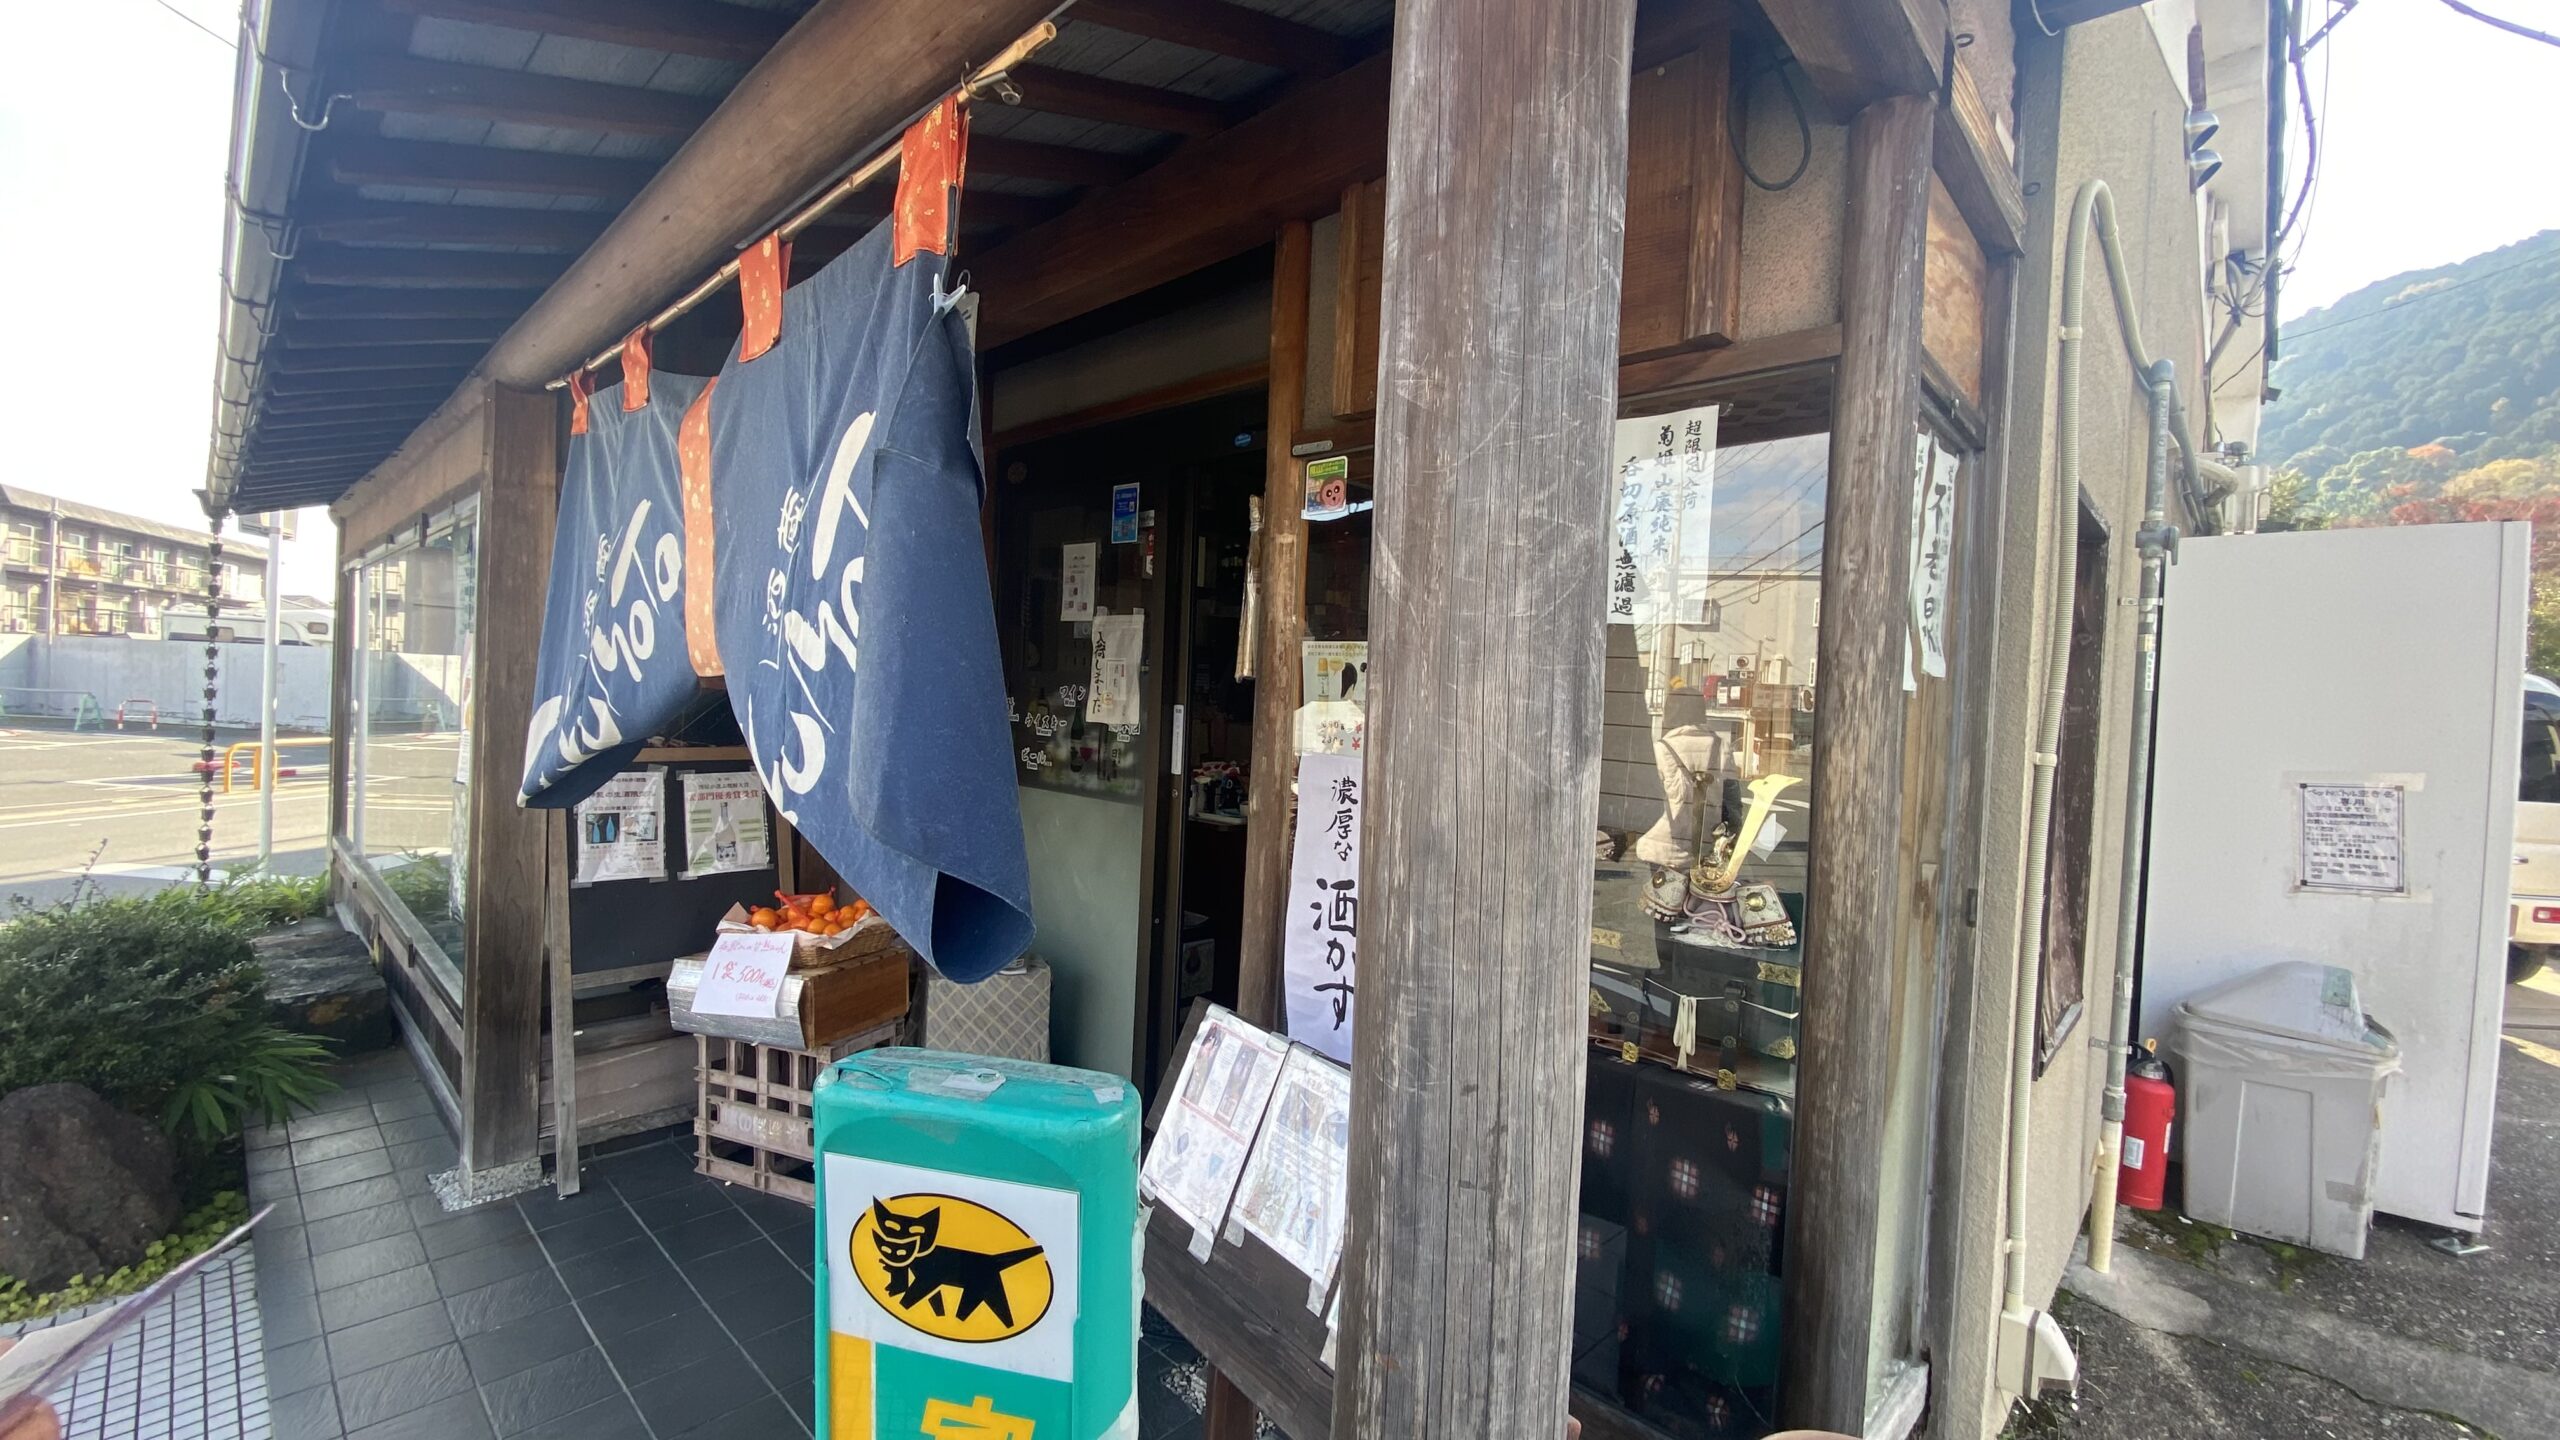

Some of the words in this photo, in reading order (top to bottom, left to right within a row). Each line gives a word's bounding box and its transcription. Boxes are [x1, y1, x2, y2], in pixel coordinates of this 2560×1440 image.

[1091, 631, 1107, 715] 入荷しました
